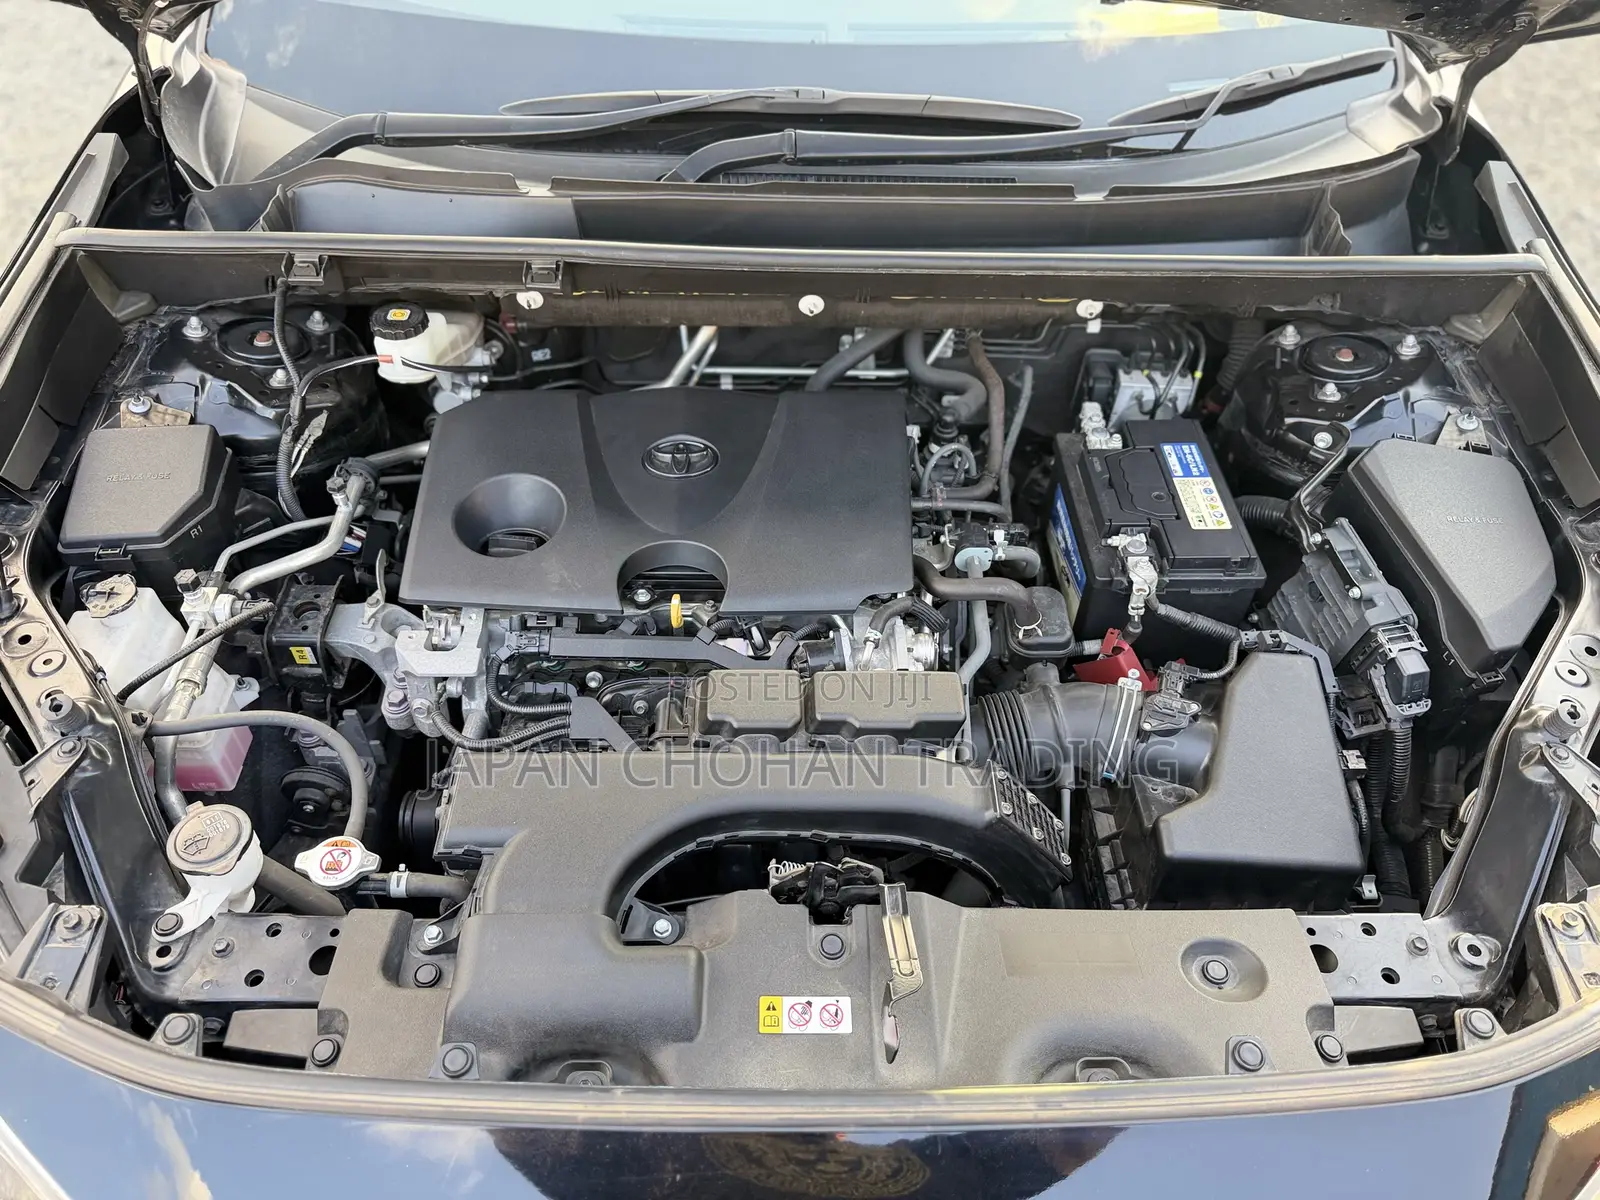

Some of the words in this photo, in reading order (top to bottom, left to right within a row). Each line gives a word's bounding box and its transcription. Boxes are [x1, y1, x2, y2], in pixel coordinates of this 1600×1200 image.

[106, 473, 138, 483] RELAY
[1446, 515, 1473, 524] RELAY
[190, 525, 203, 539] R1
[296, 650, 307, 660] R4
[1443, 651, 1455, 666] L1
